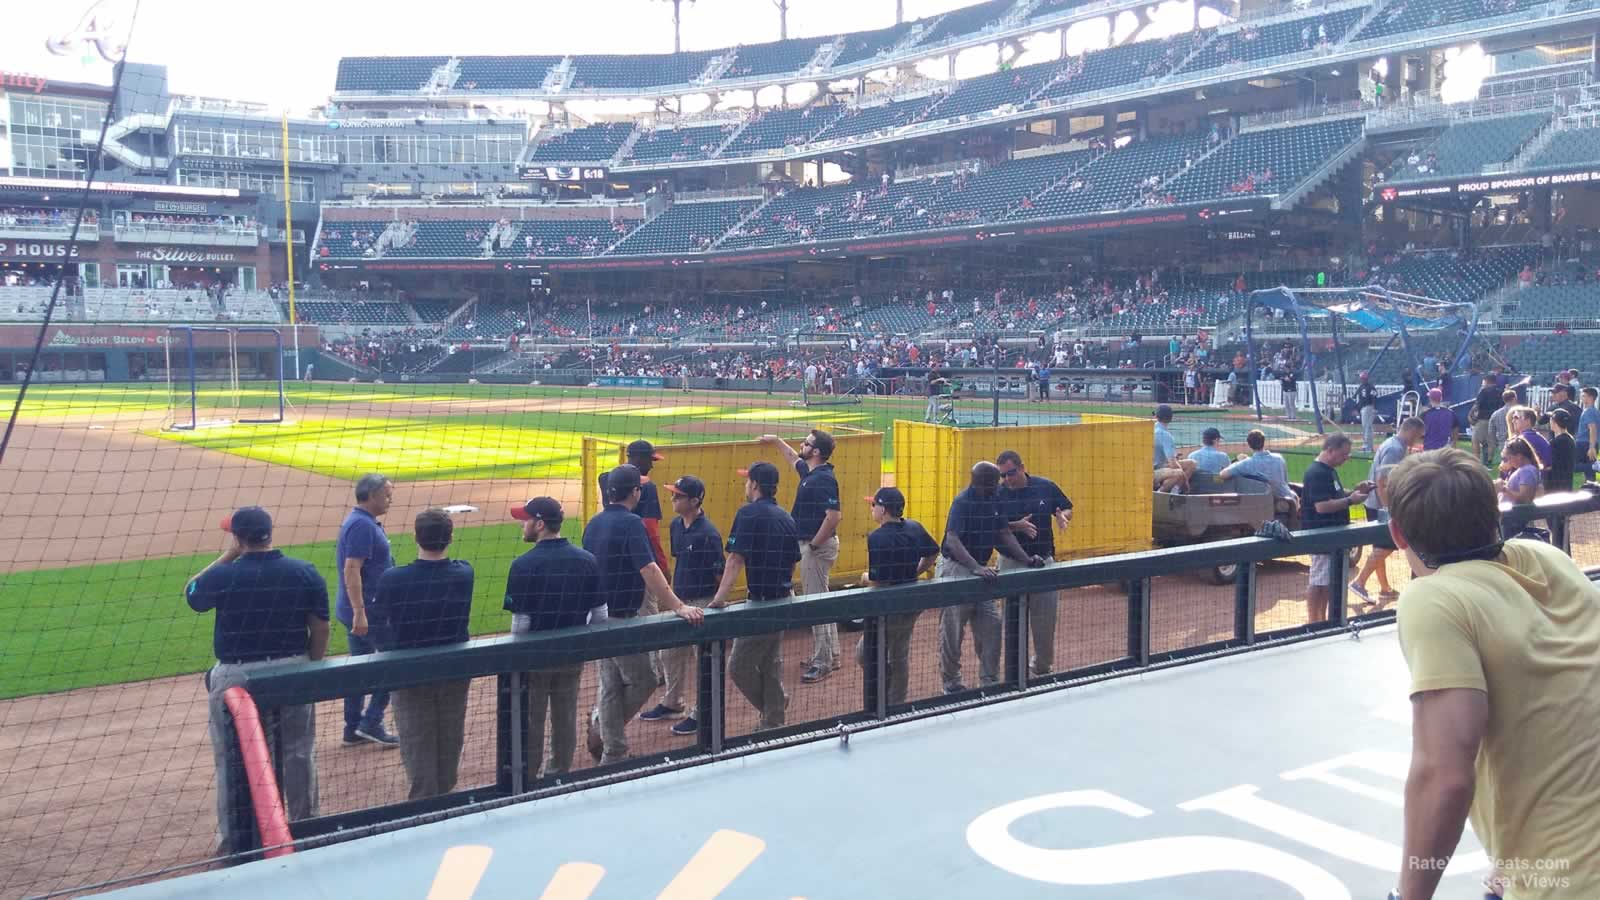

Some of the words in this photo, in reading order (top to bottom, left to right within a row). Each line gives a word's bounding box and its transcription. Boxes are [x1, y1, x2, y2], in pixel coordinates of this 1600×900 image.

[584, 169, 604, 179] 6:18
[1458, 182, 1489, 192] PROUD
[1491, 178, 1535, 190] SPONSOR
[1536, 176, 1548, 185] OF
[1551, 172, 1589, 184] BRAVES
[15, 244, 79, 257] HOUSE
[135, 250, 152, 259] THE
[152, 246, 206, 262] Silver
[206, 253, 234, 261] BULLET
